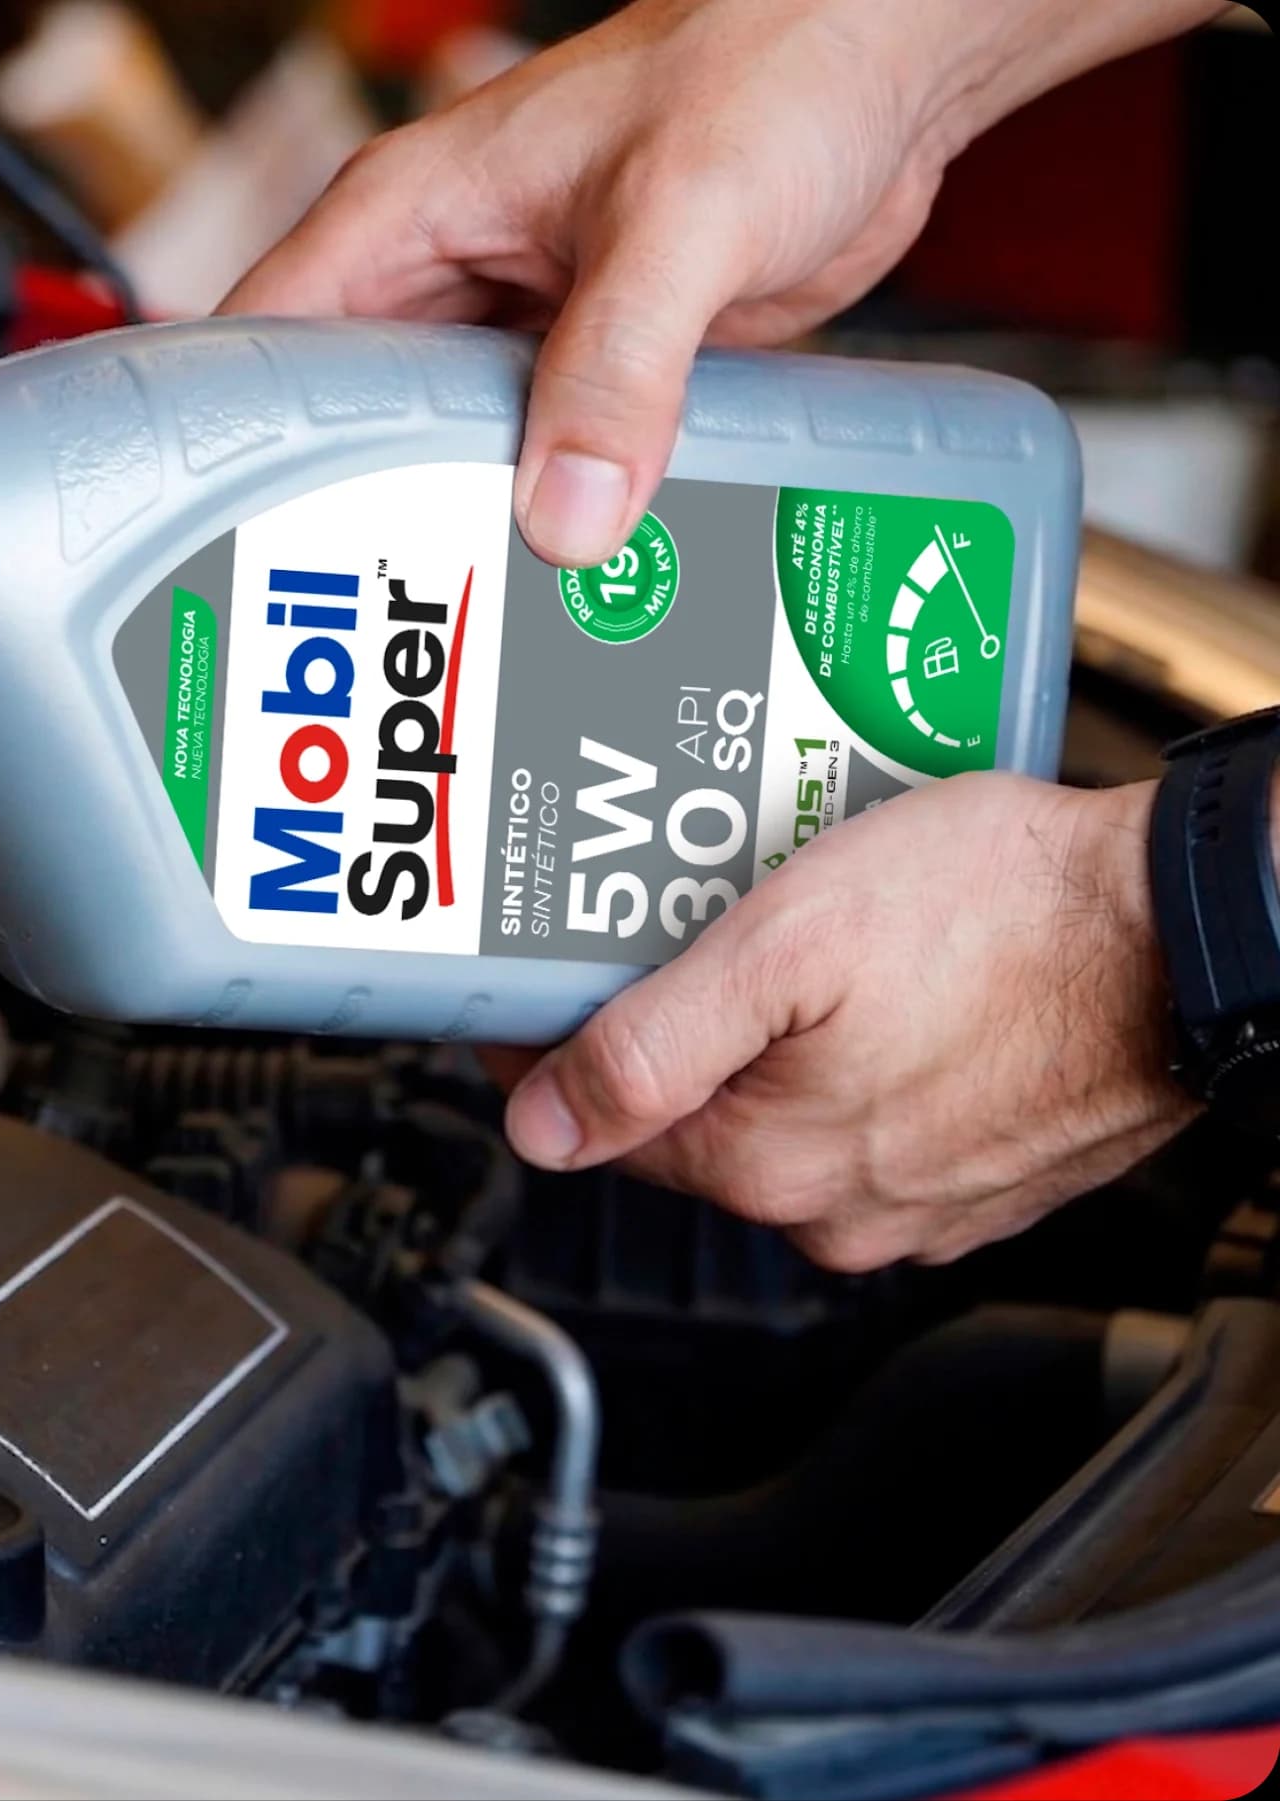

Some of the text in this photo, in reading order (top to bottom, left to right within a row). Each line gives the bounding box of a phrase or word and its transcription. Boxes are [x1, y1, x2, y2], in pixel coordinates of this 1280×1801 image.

[599, 545, 640, 604] 19
[644, 536, 672, 617] MIL KM
[791, 502, 809, 570] ATÉ 4%
[804, 504, 827, 636] DE ECONOMIA
[952, 532, 972, 549] F
[840, 505, 864, 665] Hasta un 4% de ahorro
[858, 604, 869, 623] de
[174, 609, 196, 779] NOVA TECNOLOGIA
[819, 651, 833, 678] DE
[191, 730, 204, 780] NUEVA
[248, 568, 360, 914] Mobil
[675, 686, 712, 764] API
[712, 689, 766, 773] SQ
[830, 739, 840, 752] 3
[967, 734, 981, 748] E
[500, 767, 532, 936] SINTÉTICO
[531, 781, 561, 938] SINTÉTICO
[566, 735, 658, 939] 5W
[658, 787, 748, 941] 30
